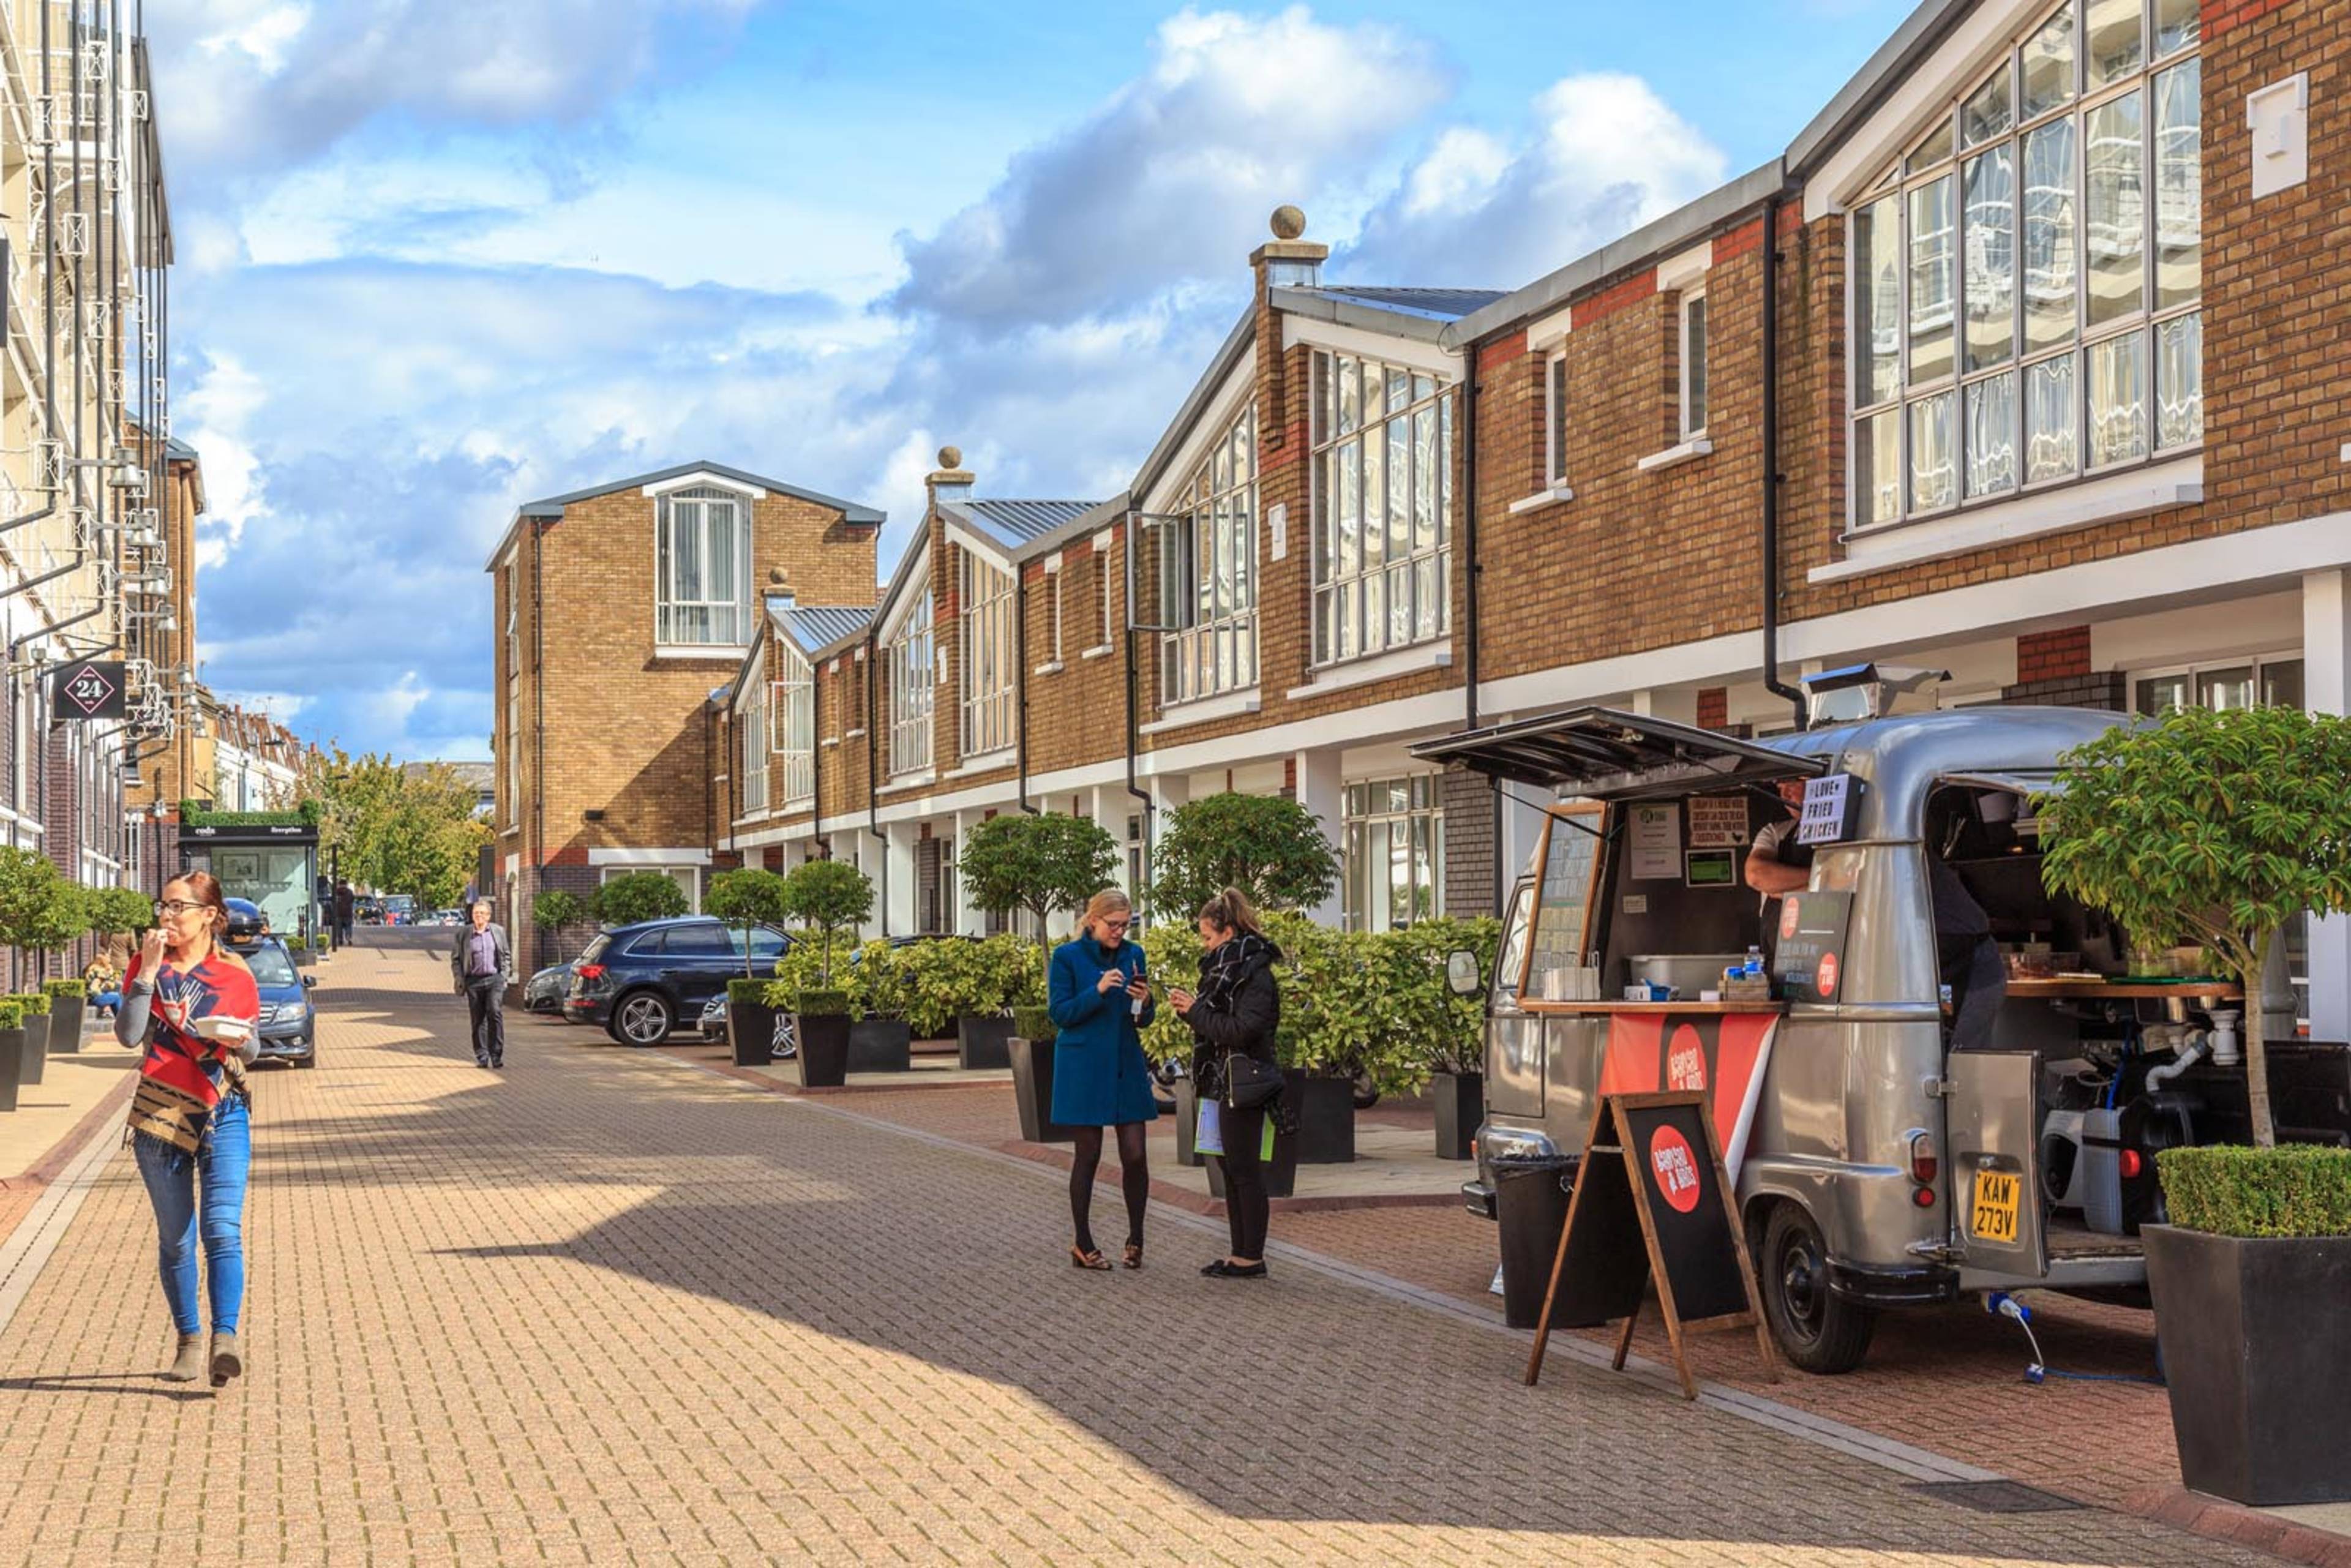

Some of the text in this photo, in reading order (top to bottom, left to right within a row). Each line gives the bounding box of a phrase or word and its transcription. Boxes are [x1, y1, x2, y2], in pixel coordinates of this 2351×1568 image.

[77, 680, 103, 697] 24
[1815, 781, 1834, 798] LOVE
[1807, 801, 1832, 818] FRIED
[1802, 821, 1838, 839] CHICKEN
[1982, 1176, 2011, 1204] KAW
[1977, 1206, 2013, 1236] 273V
